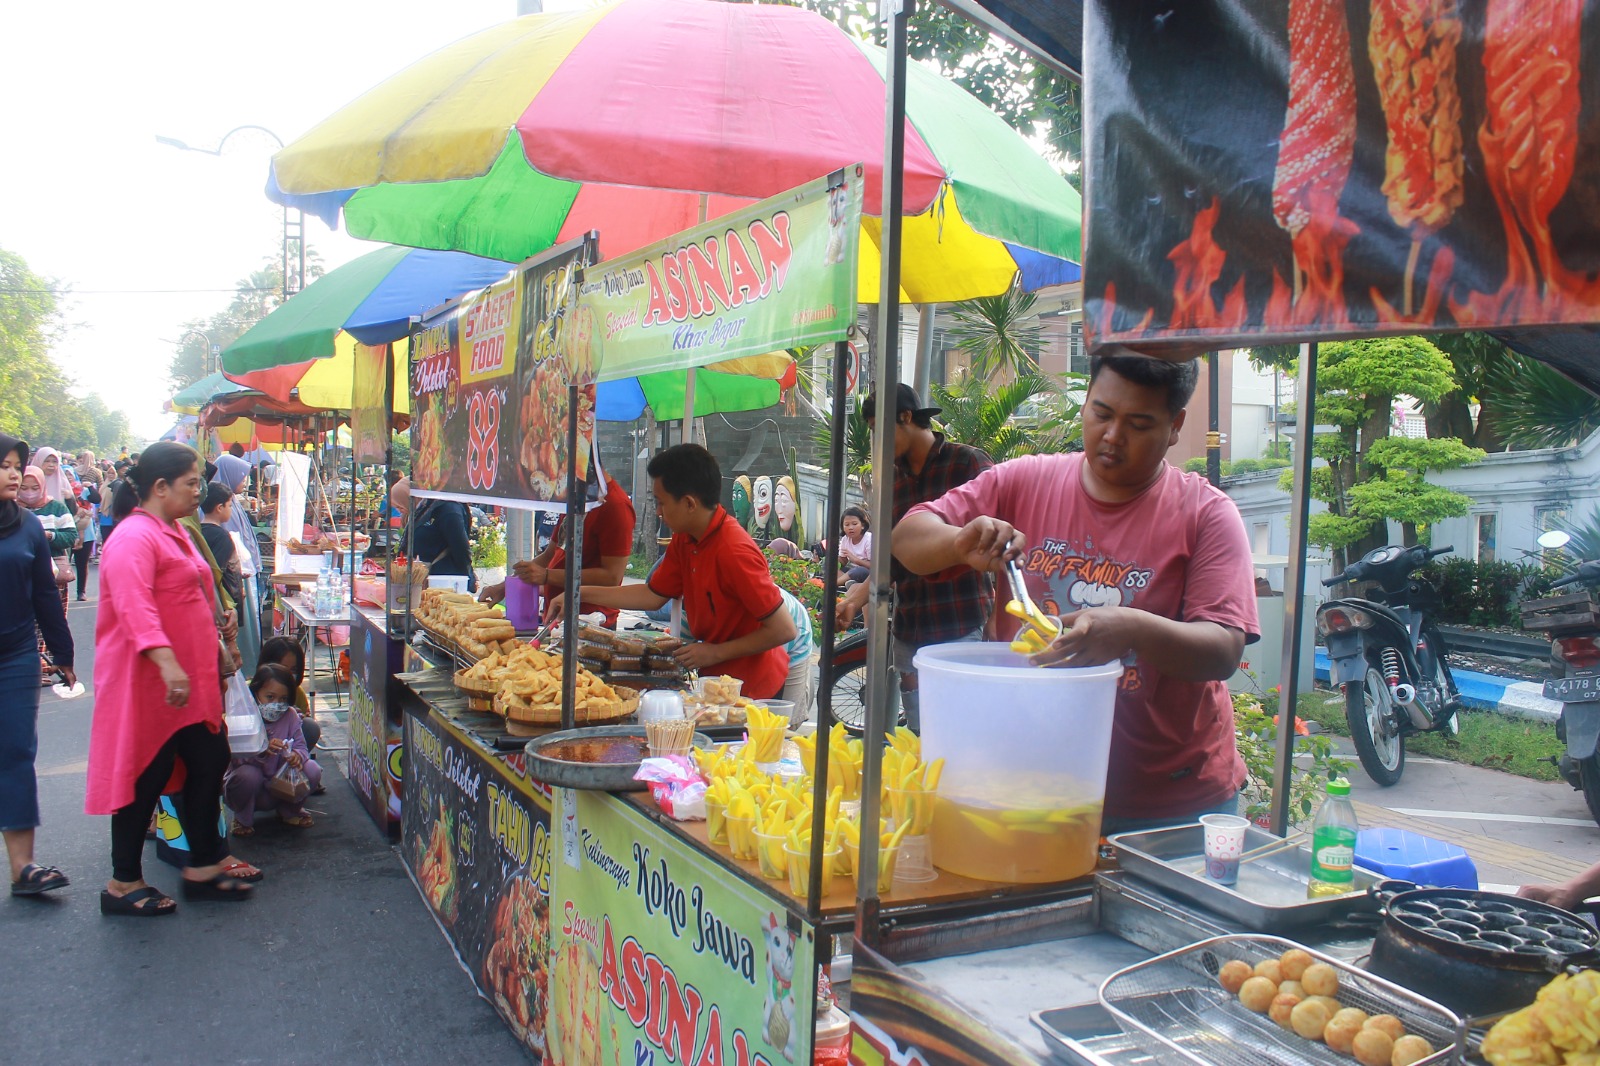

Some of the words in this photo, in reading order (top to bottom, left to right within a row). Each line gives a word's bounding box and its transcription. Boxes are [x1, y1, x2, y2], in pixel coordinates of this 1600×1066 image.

[603, 270, 624, 298] Koko
[622, 267, 646, 294] Jawa
[641, 209, 794, 329] ASINAN
[464, 288, 515, 342] STREET
[671, 322, 708, 351] Khas
[709, 315, 747, 349] Bogor
[469, 332, 505, 376] FOOD
[1026, 549, 1063, 577] BIG
[1061, 557, 1133, 589] FAMILY
[1124, 570, 1150, 589] 88
[1044, 540, 1067, 555] THE
[486, 781, 531, 870] TAHU
[580, 827, 631, 891] Kulinernya
[633, 842, 687, 939] Koko
[691, 884, 757, 986] Jawa
